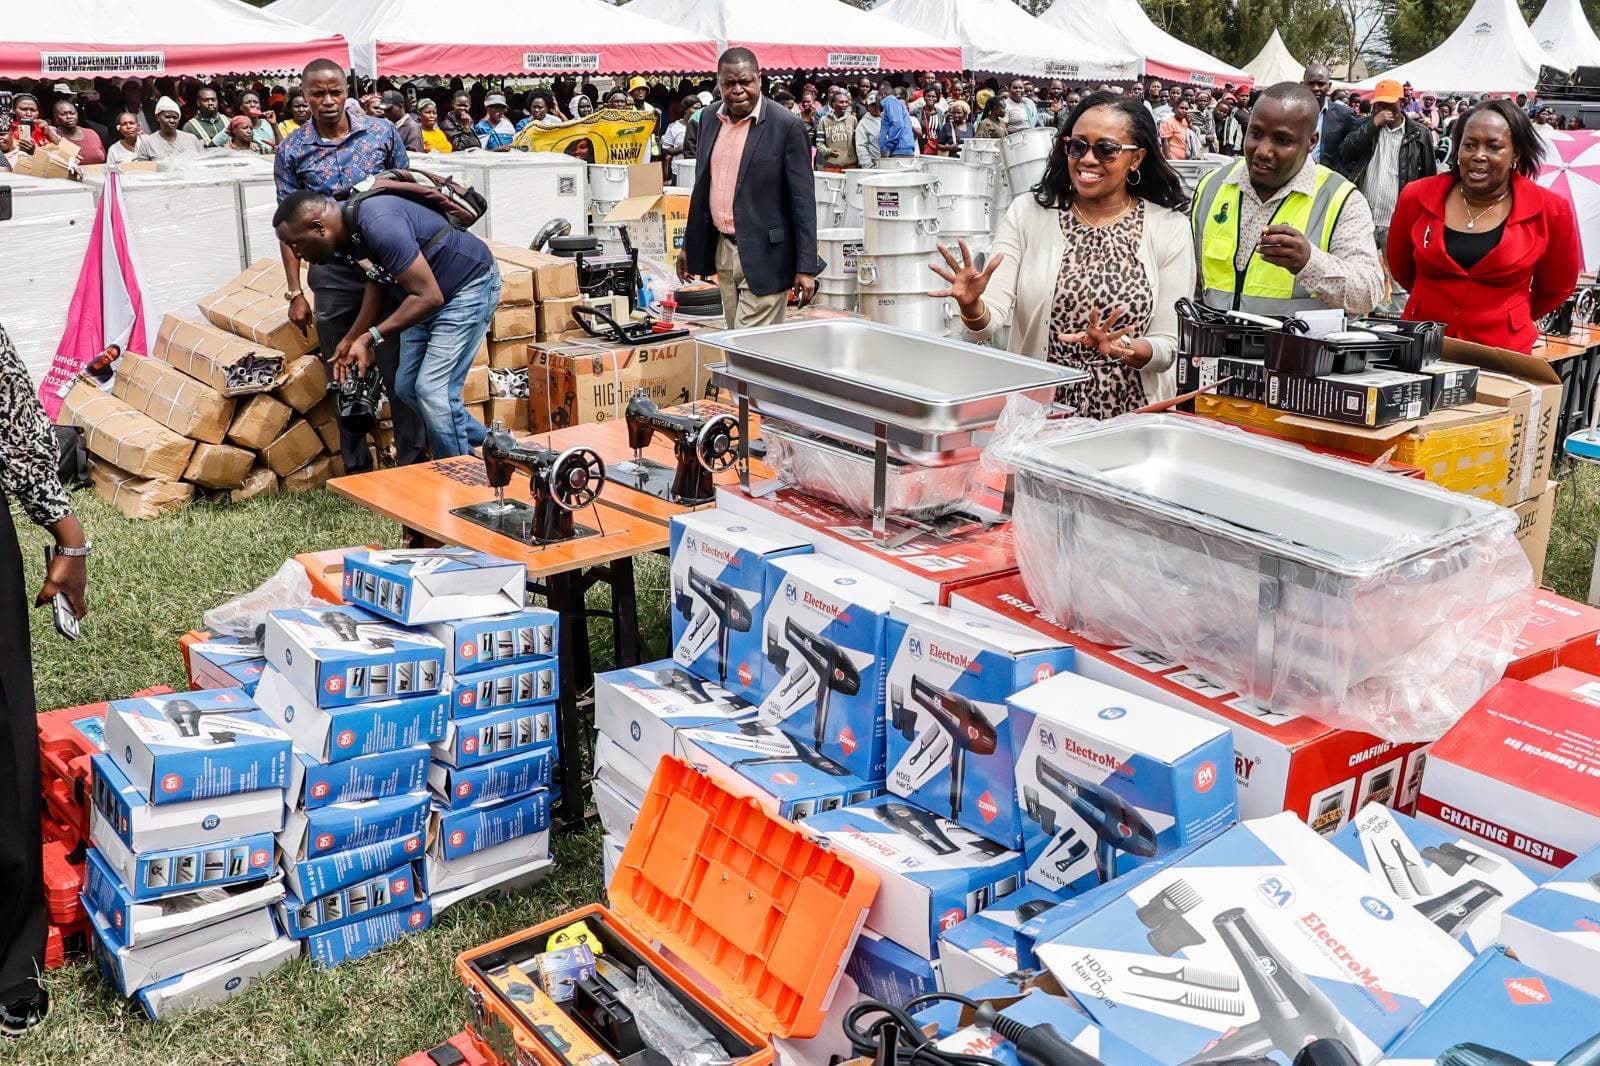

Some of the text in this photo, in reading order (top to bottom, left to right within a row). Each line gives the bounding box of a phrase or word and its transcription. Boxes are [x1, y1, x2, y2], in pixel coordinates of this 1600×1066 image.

[48, 55, 160, 66] COUNTY GOVERNMENT OF NAKURU
[55, 353, 79, 368] unds
[1506, 413, 1524, 486] WAHL
[1533, 405, 1552, 479] WAHL
[1515, 510, 1537, 534] AHL
[997, 593, 1037, 613] DISH
[929, 643, 981, 673] ElectroMa
[1065, 738, 1136, 776] ElectroMa
[1235, 756, 1254, 779] RY
[1349, 741, 1390, 767] CHAFING
[1520, 742, 1577, 770] Commercial
[1440, 805, 1555, 862] CHAFING DISH
[1080, 953, 1114, 985] HD02
[1301, 912, 1400, 1013] ElectroMa
[1070, 960, 1118, 1010] Hair Dryer
